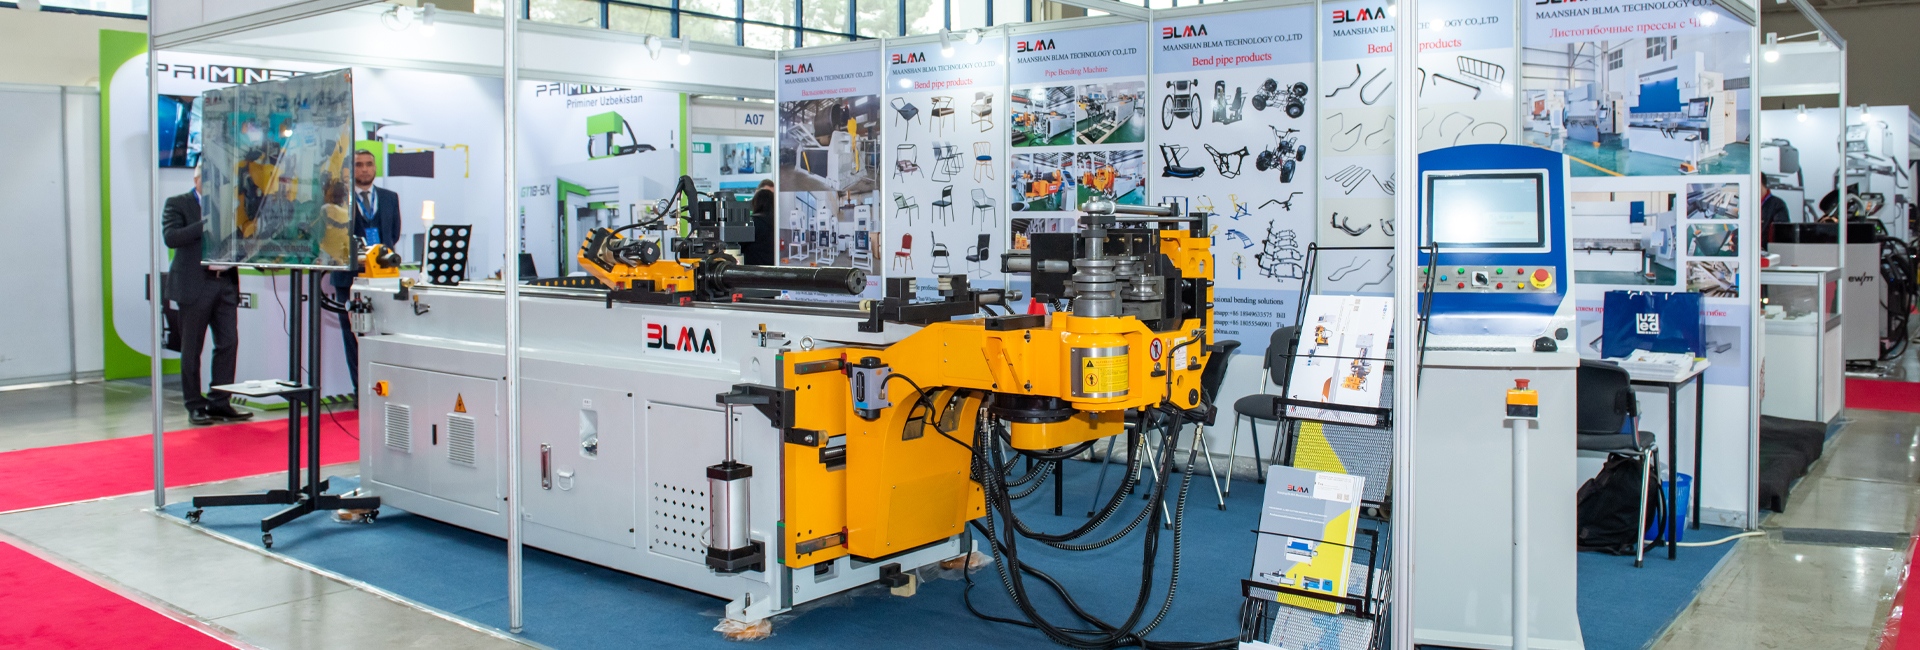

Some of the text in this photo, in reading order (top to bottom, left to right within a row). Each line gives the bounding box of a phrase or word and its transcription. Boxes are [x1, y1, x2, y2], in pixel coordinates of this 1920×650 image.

[1332, 7, 1385, 23] BLMA
[1535, 9, 1590, 19] MAANSHAN
[1592, 6, 1620, 15] BLMA
[1622, 0, 1688, 13] TECHNOLOGY
[1162, 24, 1208, 39] BLMA
[1333, 27, 1379, 37] MAANSHAN
[1465, 16, 1499, 26] CO.,LTD
[1550, 25, 1633, 38] Листогибочные
[1636, 22, 1677, 33] прессы
[1017, 39, 1055, 52] BLMA
[1163, 33, 1303, 51] MAANSHAN BLMA TECHNOLOGY CO.,LTD
[1367, 38, 1462, 54] Bend products
[892, 52, 926, 64] BLMA
[1017, 55, 1051, 63] MAANSHAN
[1070, 50, 1111, 59] TECHNOLOGY
[1192, 52, 1272, 67] Bend pipe products
[785, 63, 814, 75] BLMA
[938, 63, 973, 71] TECHNOLOGY
[1045, 65, 1108, 78] Pipe Bending Machine
[824, 73, 855, 81] TECHNOLOGY
[914, 78, 973, 90] Bend pipe products
[567, 95, 642, 109] Priminer Uzbekistan
[744, 113, 764, 125] A07
[1233, 297, 1256, 305] bending
[1258, 297, 1284, 305] solutions
[647, 322, 717, 355] BLMA
[1287, 484, 1309, 493] BLMA
